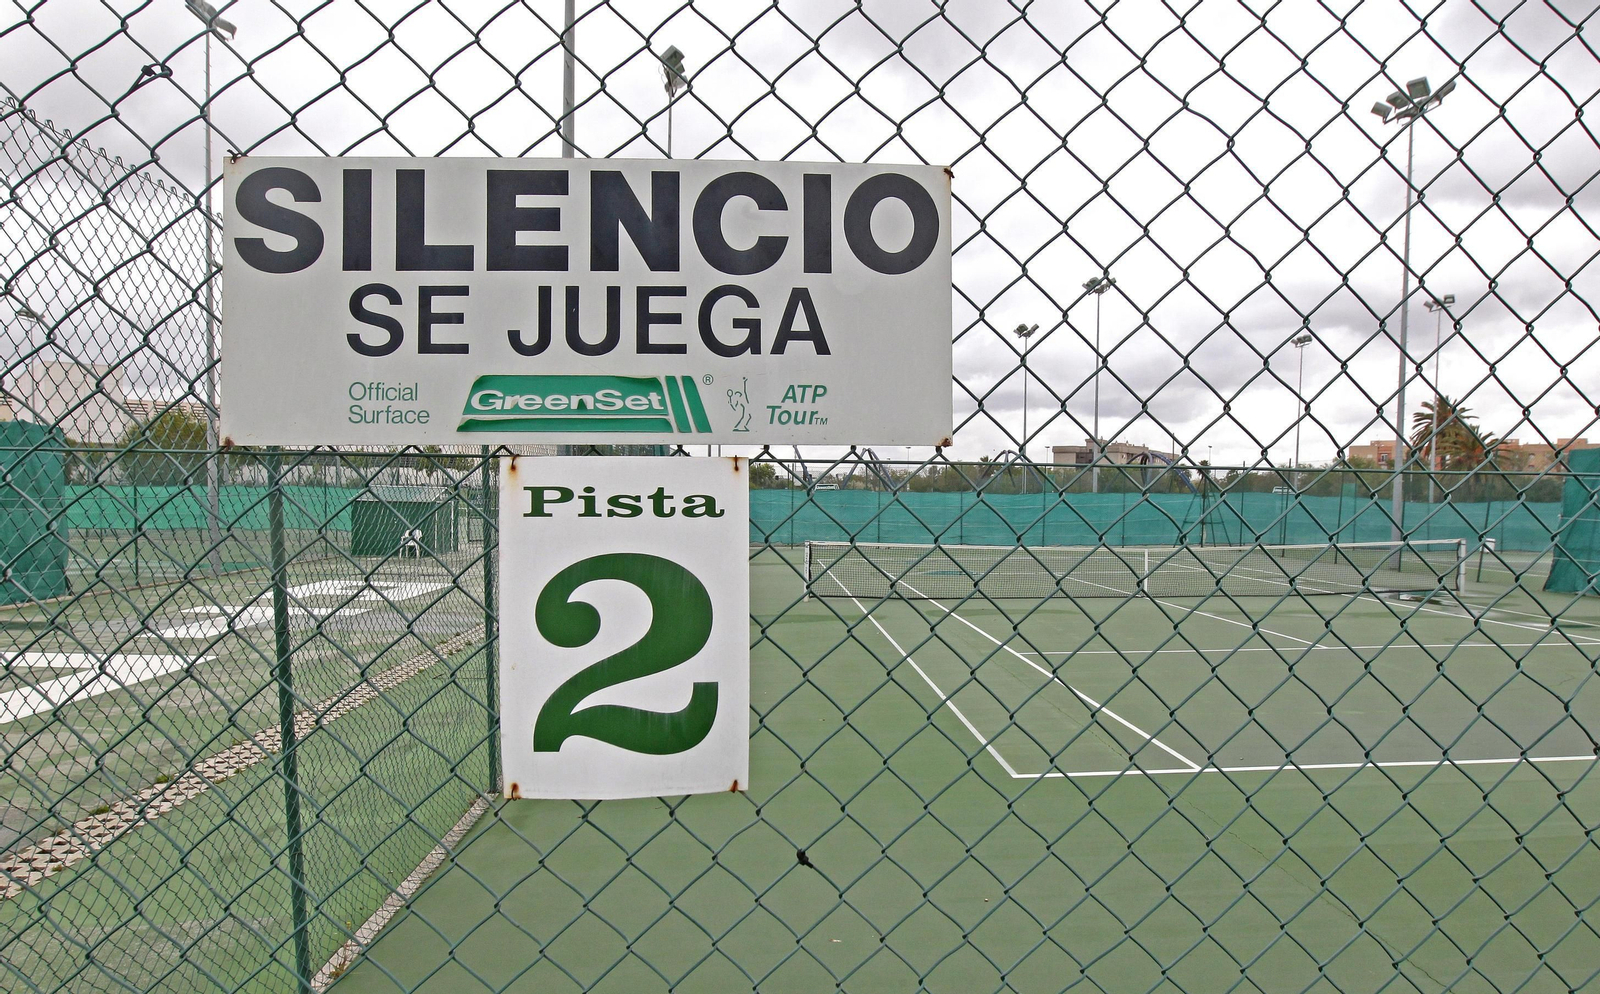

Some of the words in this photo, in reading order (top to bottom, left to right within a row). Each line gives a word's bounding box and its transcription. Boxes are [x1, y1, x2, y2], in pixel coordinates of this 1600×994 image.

[234, 166, 940, 275] SILENCIO
[346, 283, 470, 358] SE
[507, 283, 832, 358] JUEGA
[348, 381, 419, 402] Official
[470, 389, 665, 411] GreenSet
[780, 384, 828, 404] ATP
[347, 404, 430, 425] Surface
[522, 485, 726, 519] Pista
[533, 552, 719, 756] 2
